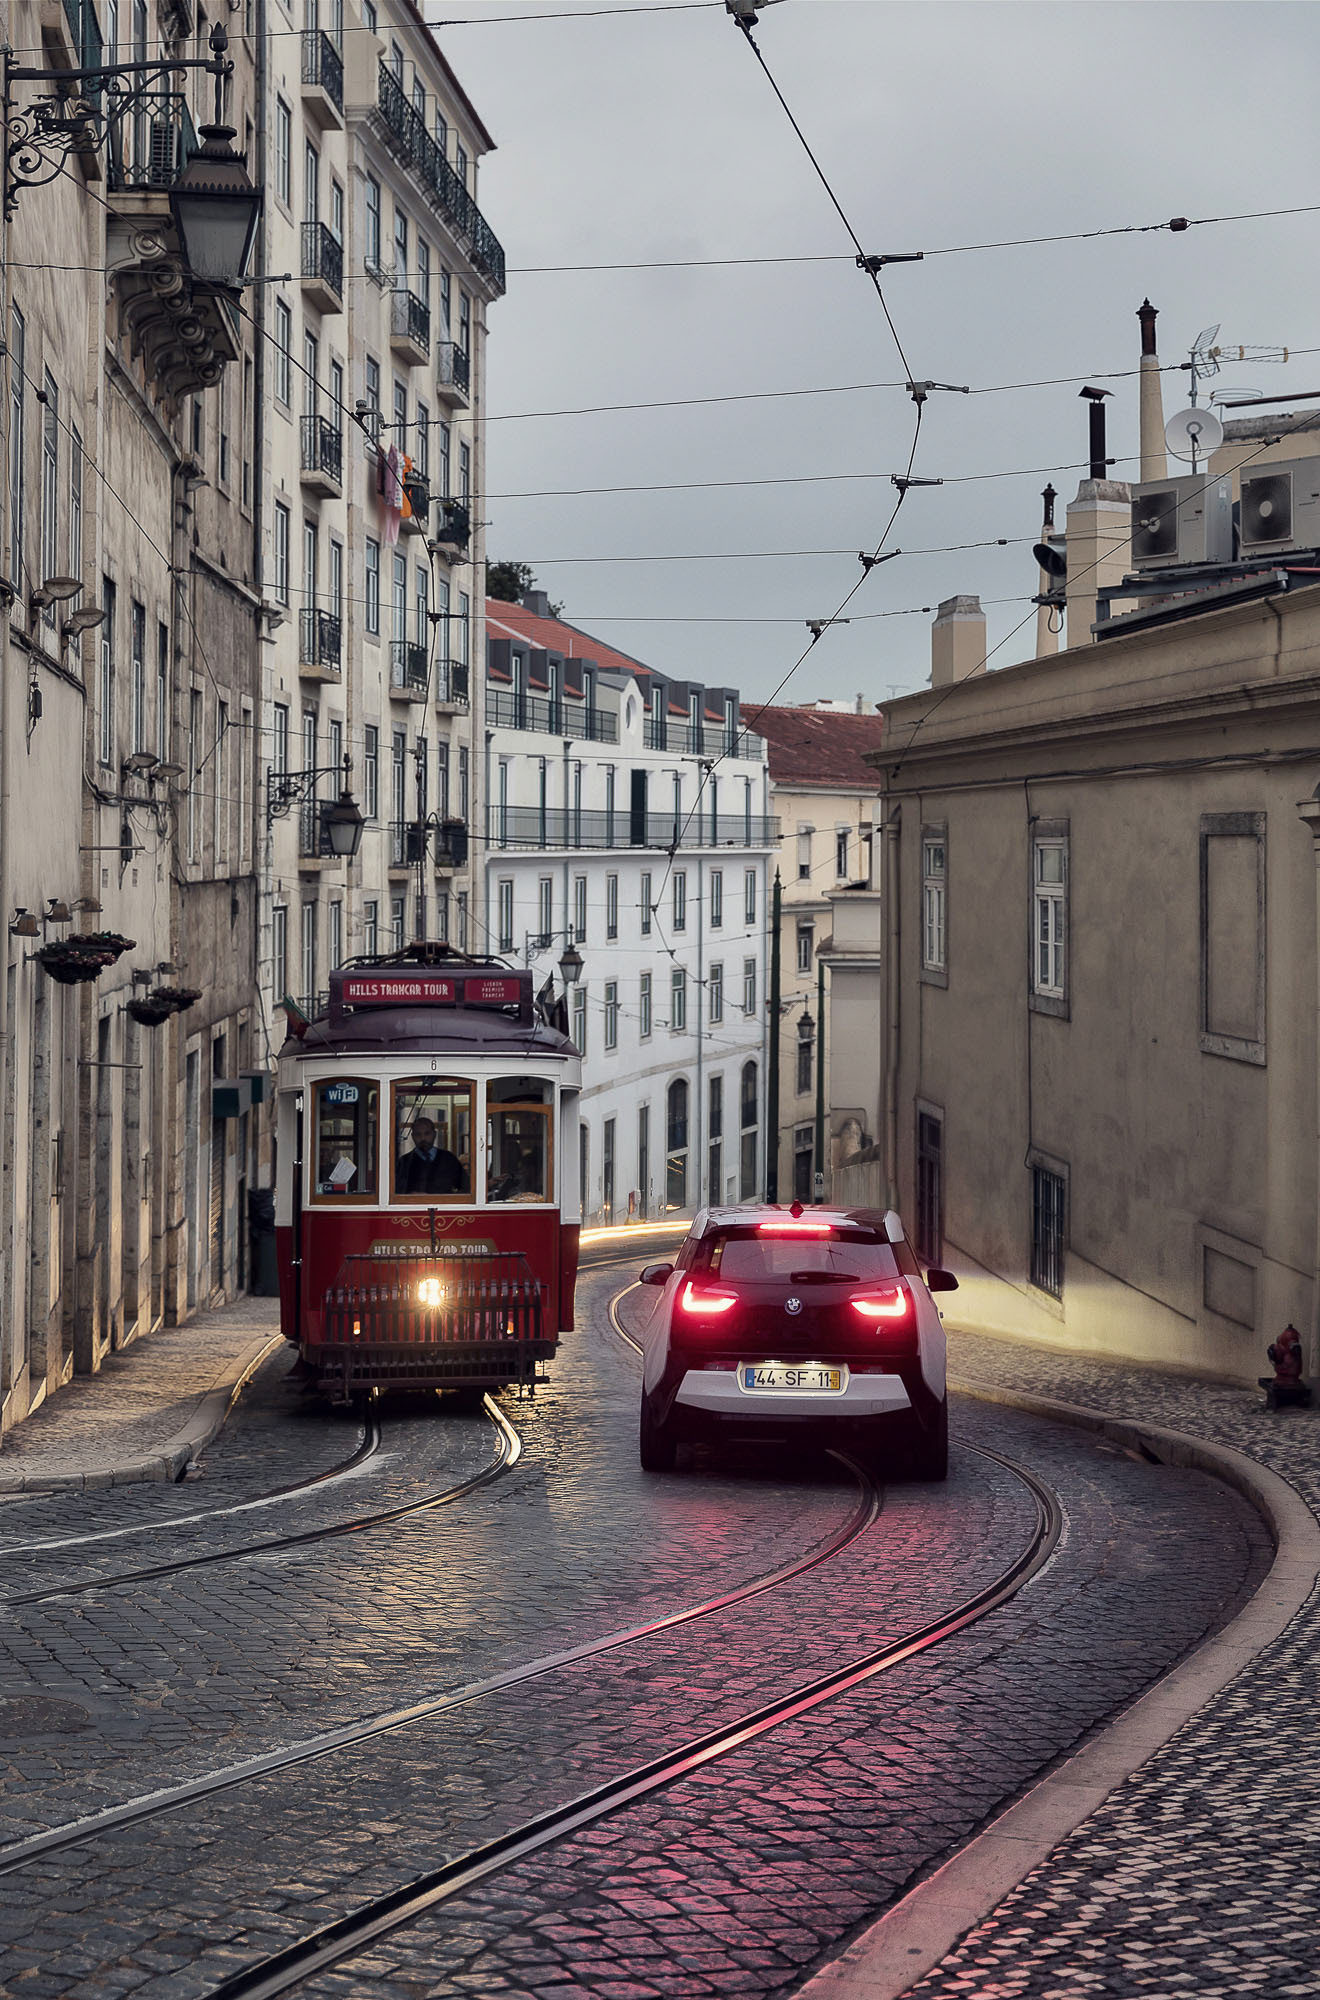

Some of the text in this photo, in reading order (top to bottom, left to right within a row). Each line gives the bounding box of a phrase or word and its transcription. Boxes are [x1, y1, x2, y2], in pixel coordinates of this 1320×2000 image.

[349, 983, 449, 996] HILLS TRAMCAR TOUR
[431, 1059, 437, 1071] 6
